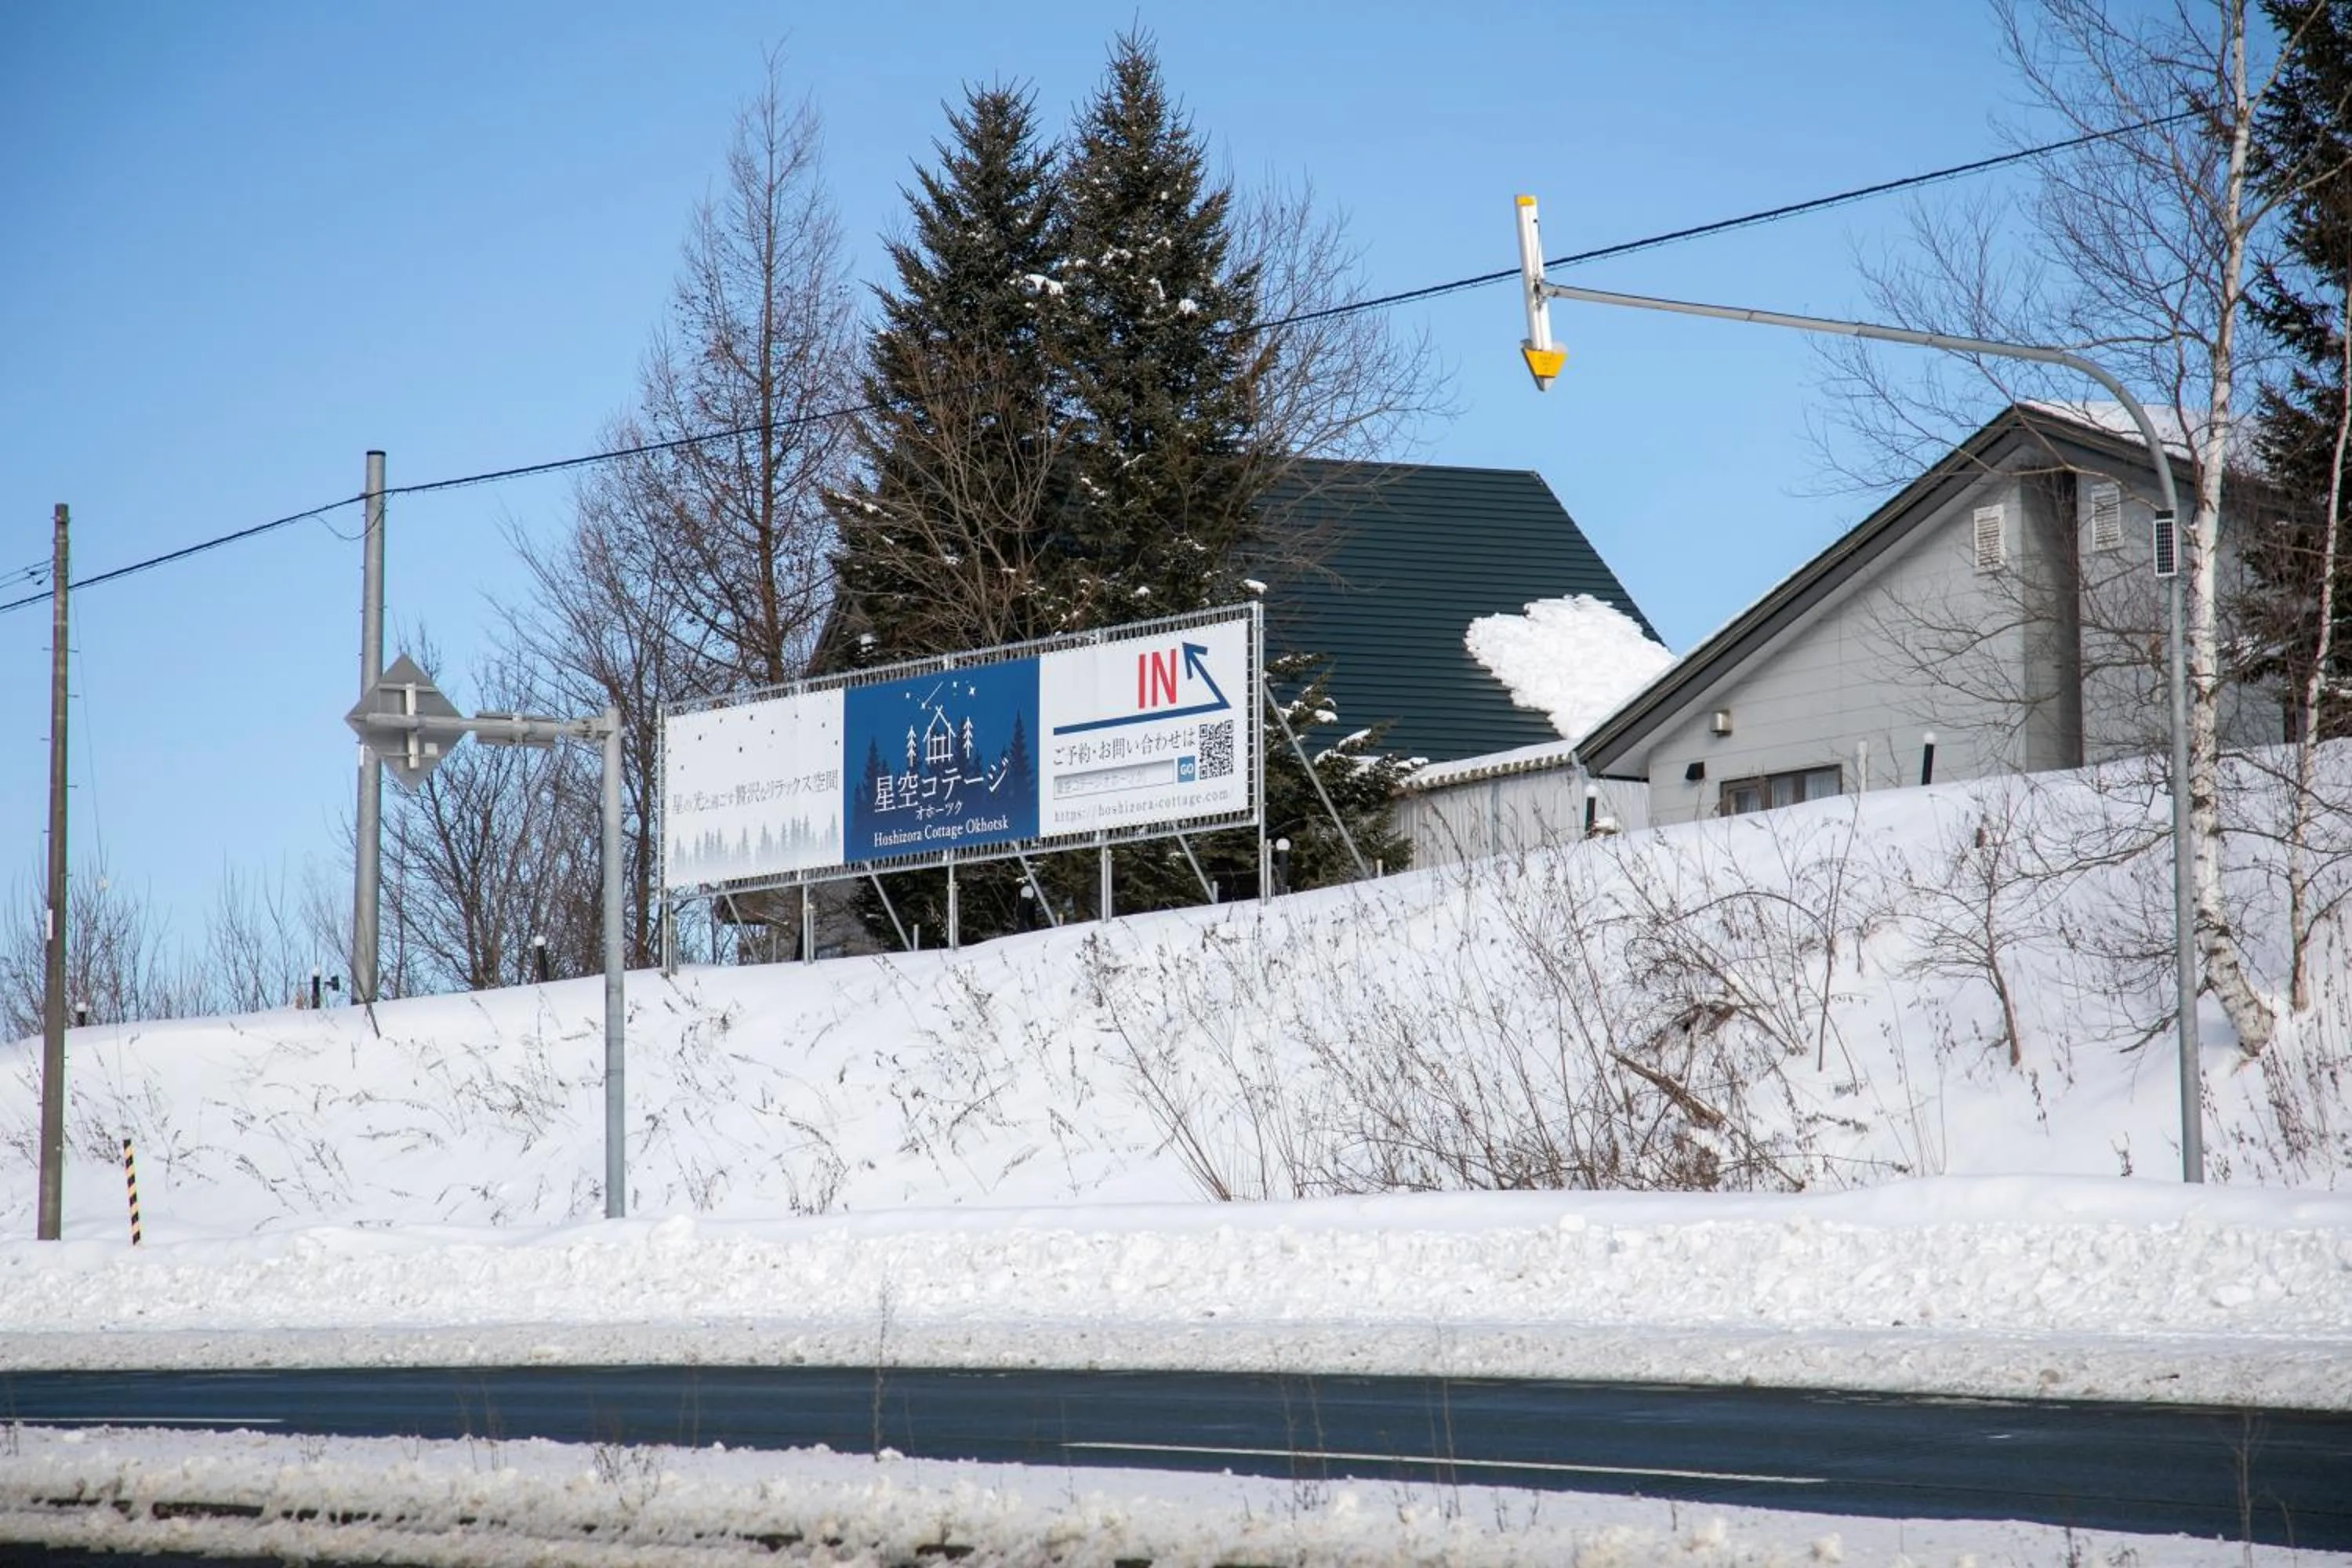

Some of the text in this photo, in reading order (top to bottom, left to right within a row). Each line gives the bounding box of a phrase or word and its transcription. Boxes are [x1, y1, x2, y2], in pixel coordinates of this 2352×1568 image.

[1138, 648, 1177, 710] IN
[1053, 727, 1196, 766] ご予約・お問い合わせは
[874, 757, 1010, 813] 星空コテージ
[1180, 763, 1194, 775] GO
[915, 800, 963, 821] オホーツク
[874, 815, 1010, 848] Hoshizora Cottage Okhotsk
